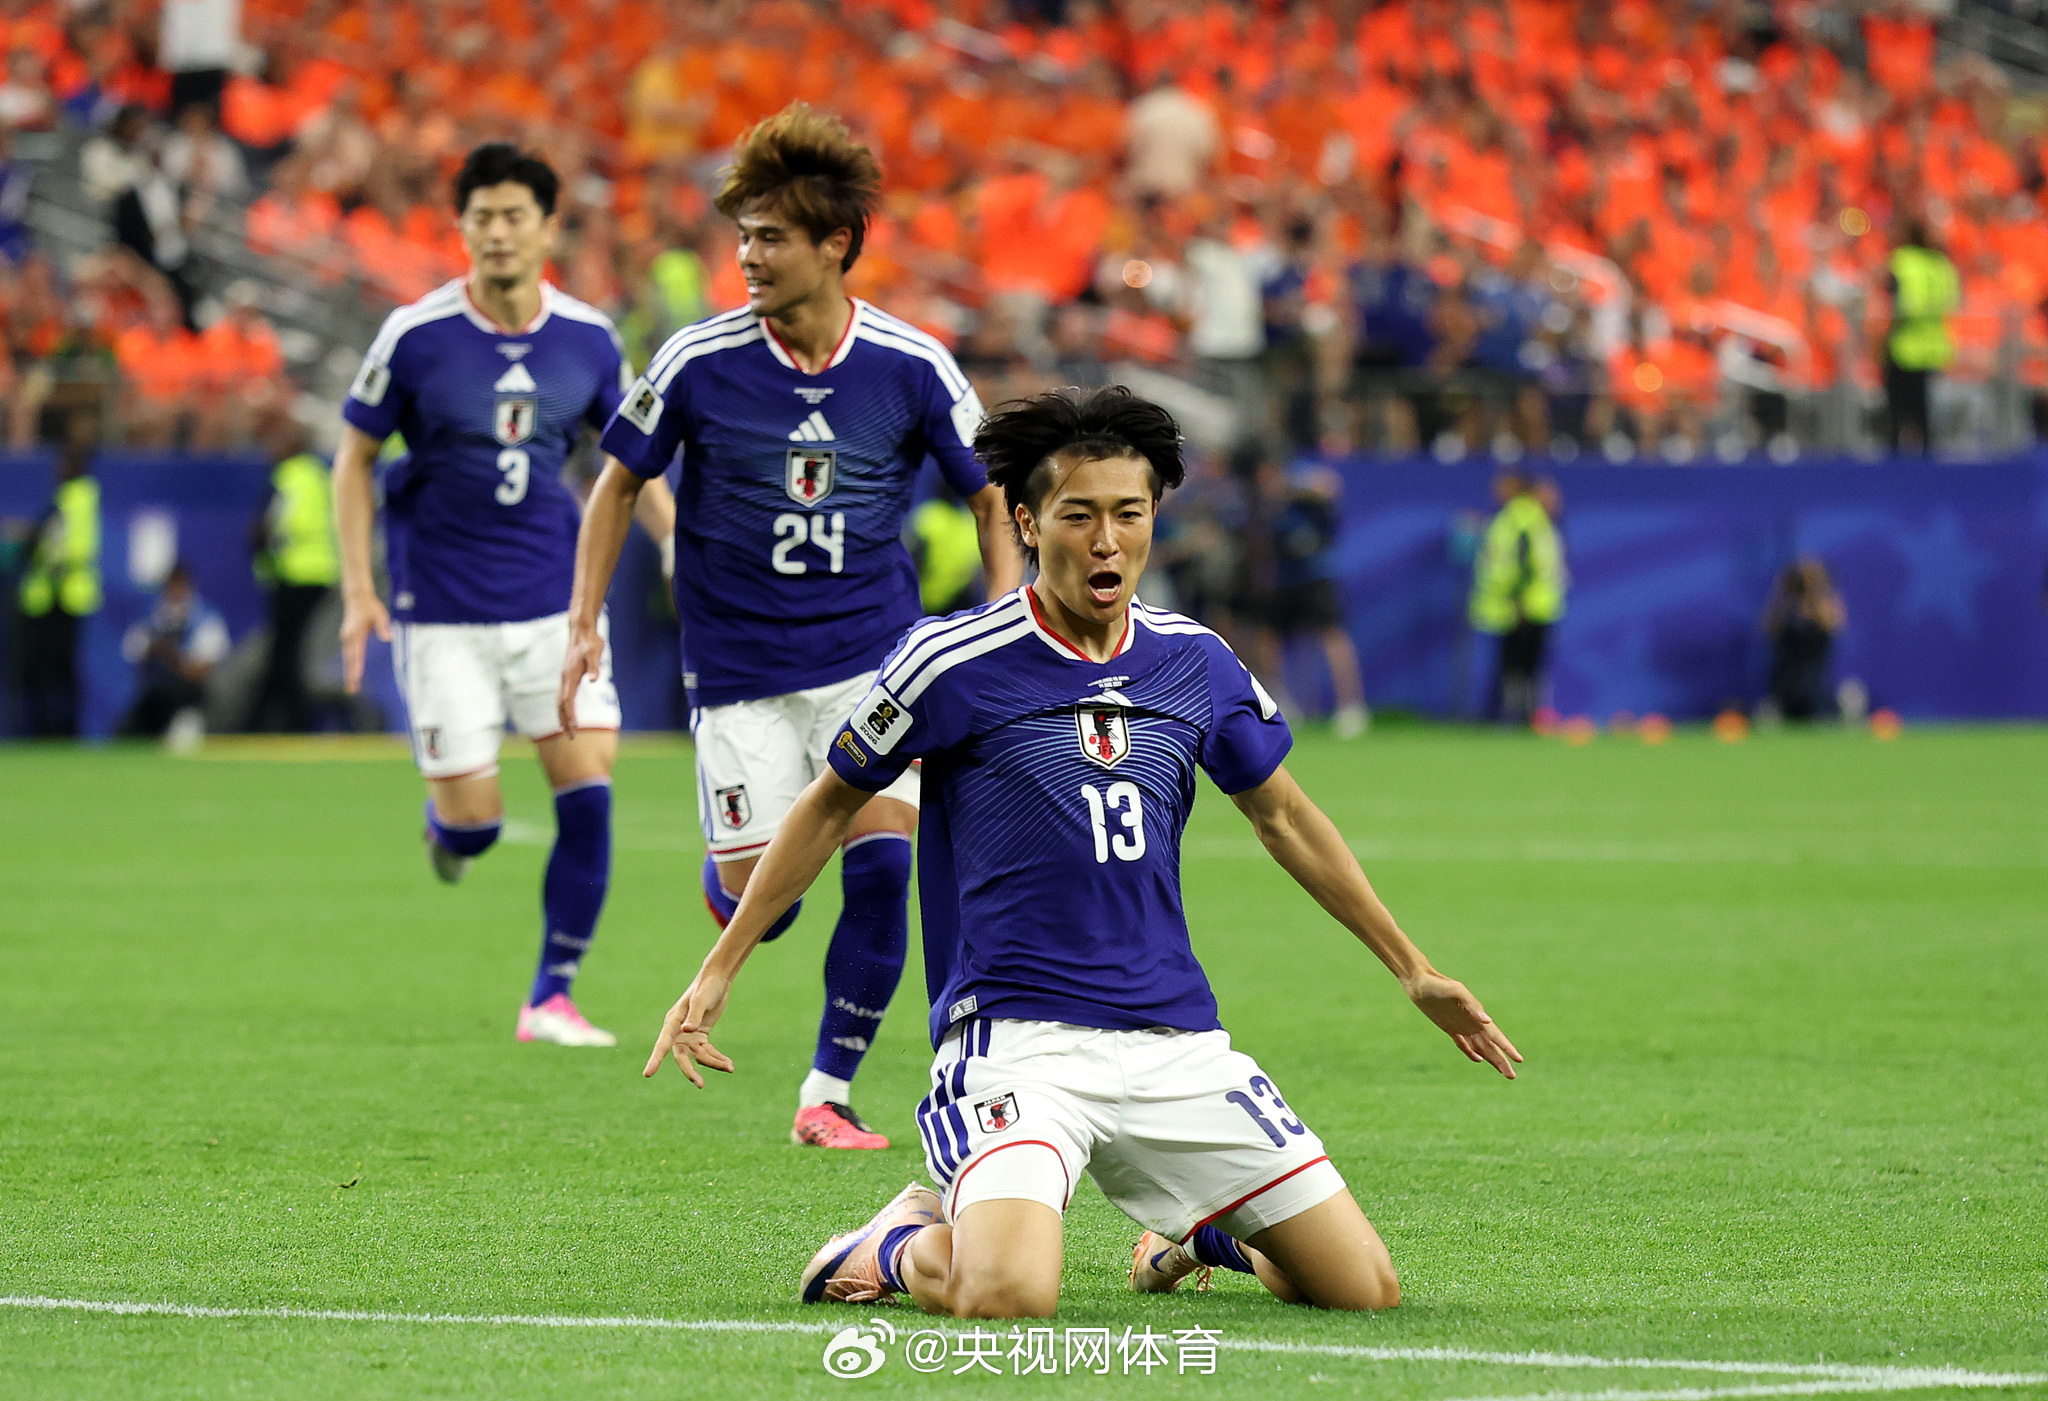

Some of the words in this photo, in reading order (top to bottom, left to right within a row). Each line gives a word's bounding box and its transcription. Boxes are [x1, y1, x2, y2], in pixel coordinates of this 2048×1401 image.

[494, 449, 531, 506] 3
[772, 511, 845, 575] 24
[859, 725, 878, 745] 2026
[1095, 744, 1118, 756] JFA
[1080, 781, 1147, 864] 13
[1225, 1075, 1305, 1148] 13
